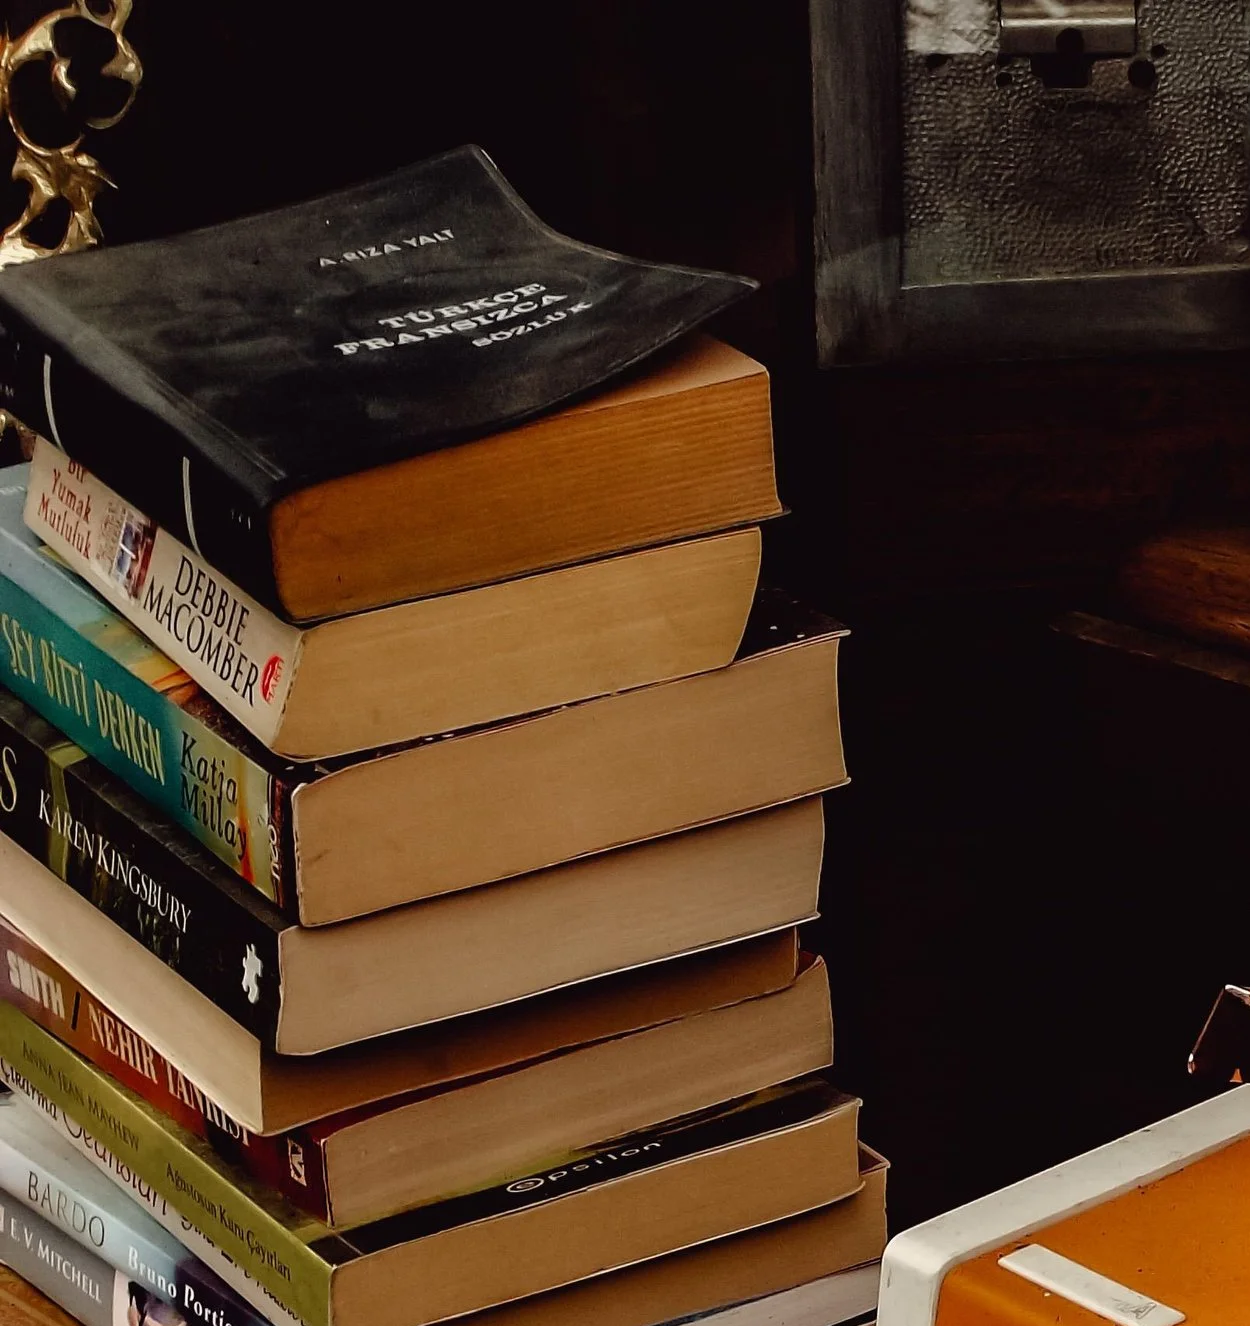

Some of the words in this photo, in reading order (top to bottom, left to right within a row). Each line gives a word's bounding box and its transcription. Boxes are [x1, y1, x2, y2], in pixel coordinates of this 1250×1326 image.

[333, 294, 568, 356] FRANSIZCA
[38, 492, 91, 560] Mutluluk
[52, 468, 91, 525] Yumak
[143, 575, 258, 708] MACOMBER
[175, 555, 250, 646] DEBBIE
[93, 679, 165, 787] DERKEN
[180, 730, 238, 805] Katja
[180, 773, 248, 862] Millay
[38, 789, 96, 860] KAREN
[96, 835, 192, 934] KINGSBURY
[6, 949, 66, 1021] SMITH
[22, 1040, 57, 1085] ANNA
[58, 1071, 86, 1107] JEAN
[87, 1095, 141, 1152] MAYHEW
[23, 1227, 36, 1252] V.
[37, 1237, 102, 1305] MITCHELL
[27, 1170, 106, 1248] BARDO
[127, 1244, 178, 1299] Bruno
[219, 1204, 246, 1243] Kuru
[246, 1229, 292, 1282] Çayırları
